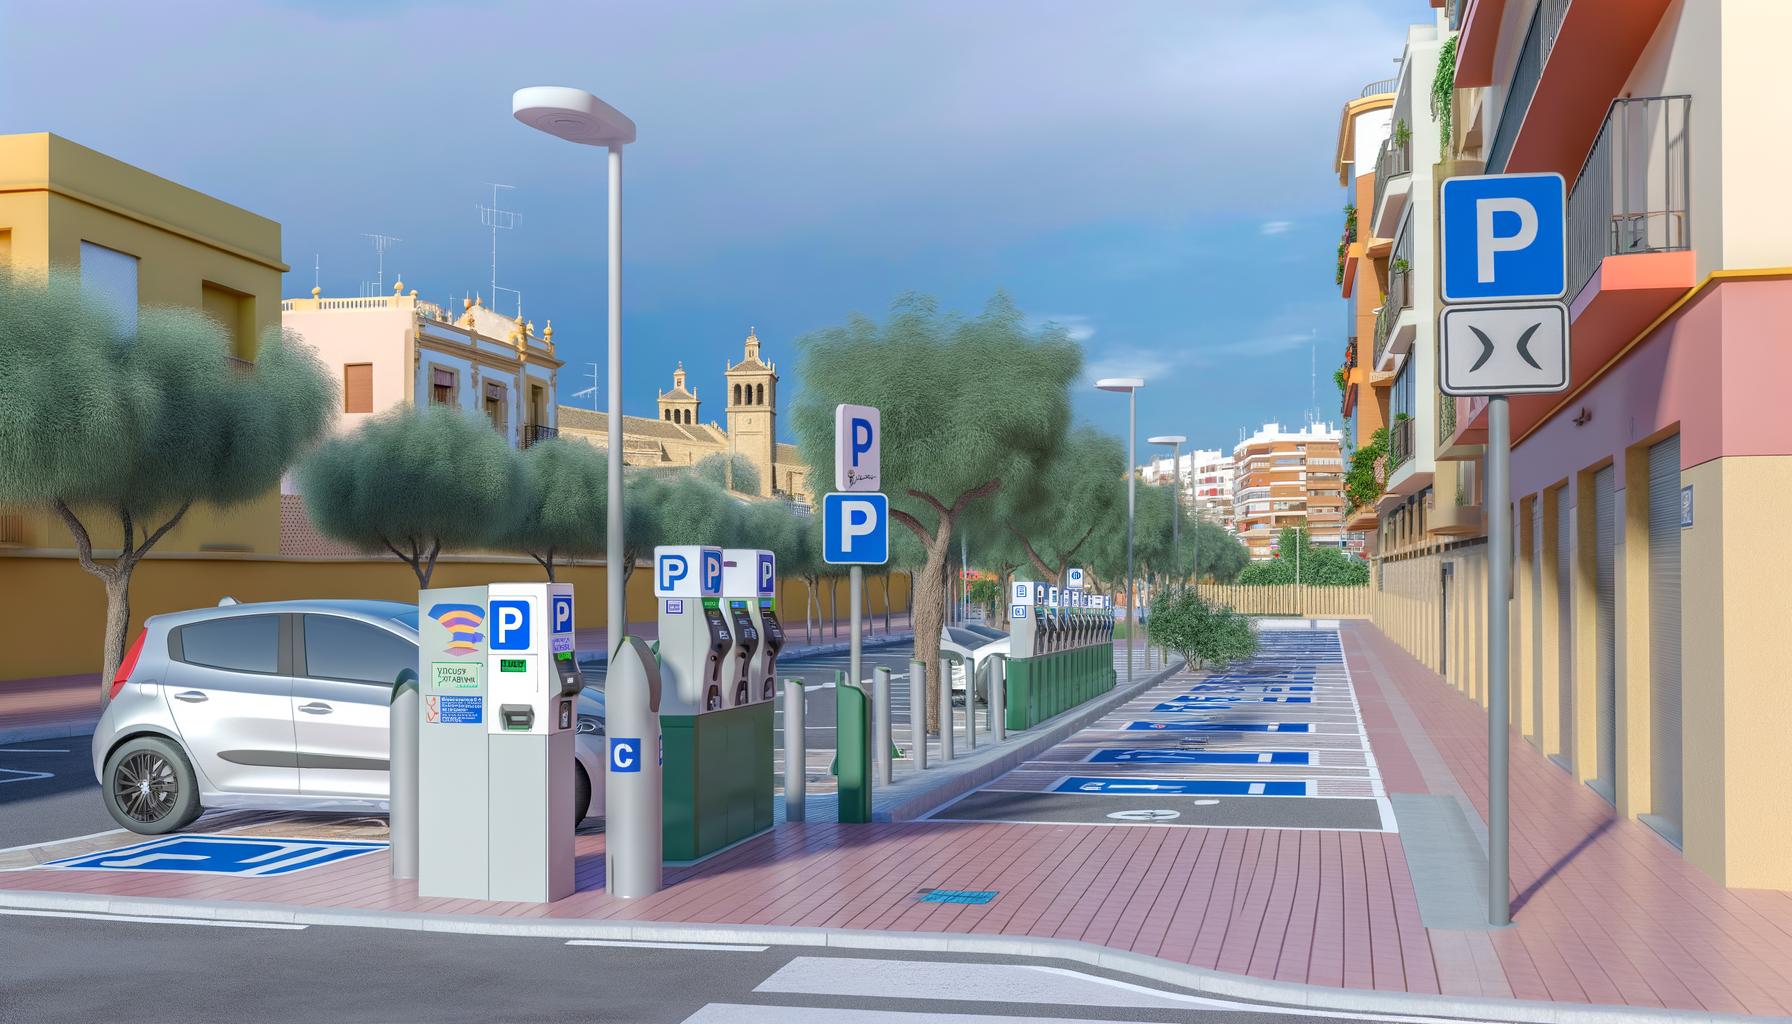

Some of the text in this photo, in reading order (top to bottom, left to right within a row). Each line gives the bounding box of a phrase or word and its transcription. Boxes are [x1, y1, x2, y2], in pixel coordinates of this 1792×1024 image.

[1476, 197, 1539, 284] P
[851, 417, 873, 467] P
[841, 500, 877, 553] P
[662, 557, 686, 588] P
[707, 557, 720, 588] P
[762, 561, 772, 588] P
[498, 606, 523, 644] P
[556, 601, 570, 631] P
[613, 743, 633, 768] C
